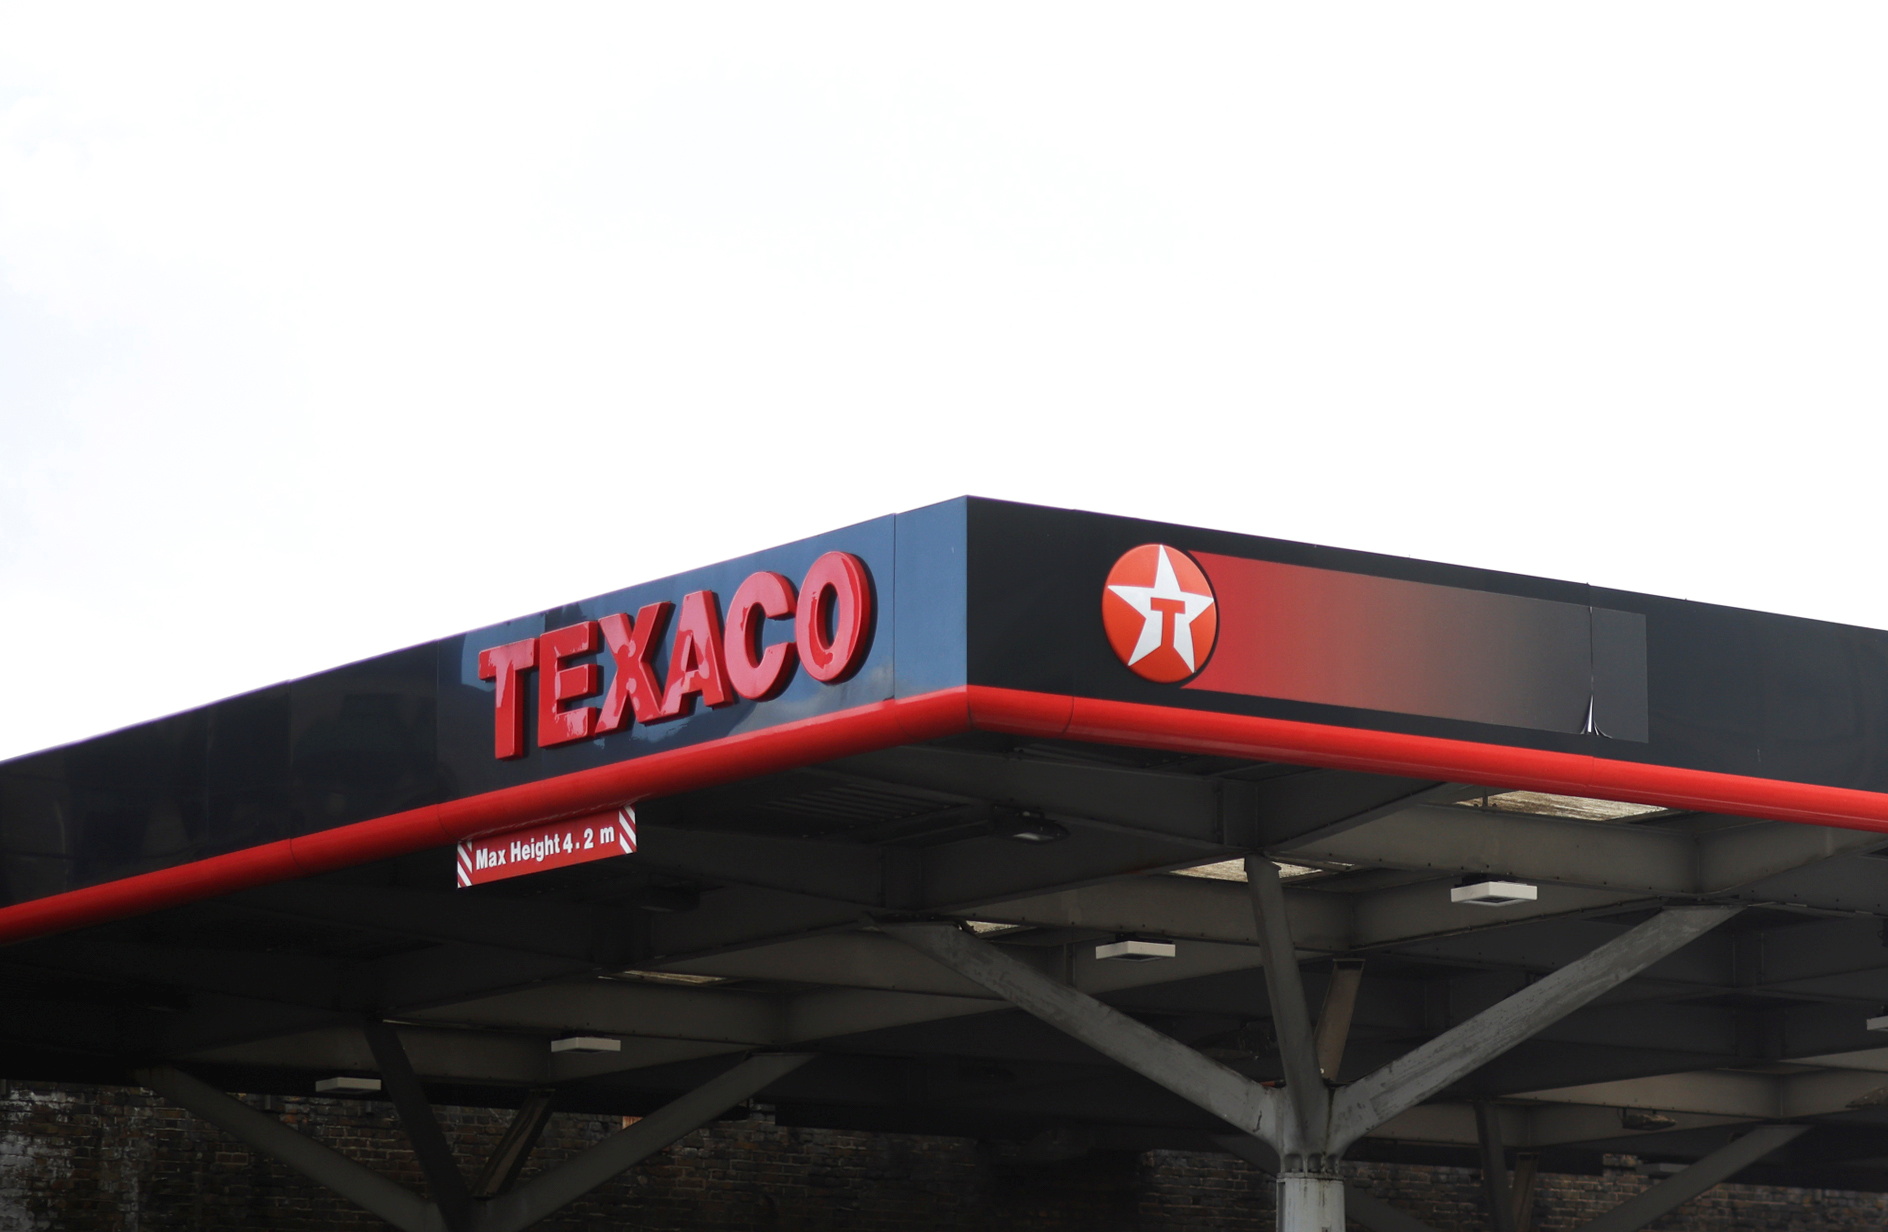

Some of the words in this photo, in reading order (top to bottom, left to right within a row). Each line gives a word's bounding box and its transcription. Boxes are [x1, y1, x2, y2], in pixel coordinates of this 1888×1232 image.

[479, 551, 871, 759] TEXACO
[476, 848, 507, 870] Max
[511, 834, 560, 862] Height
